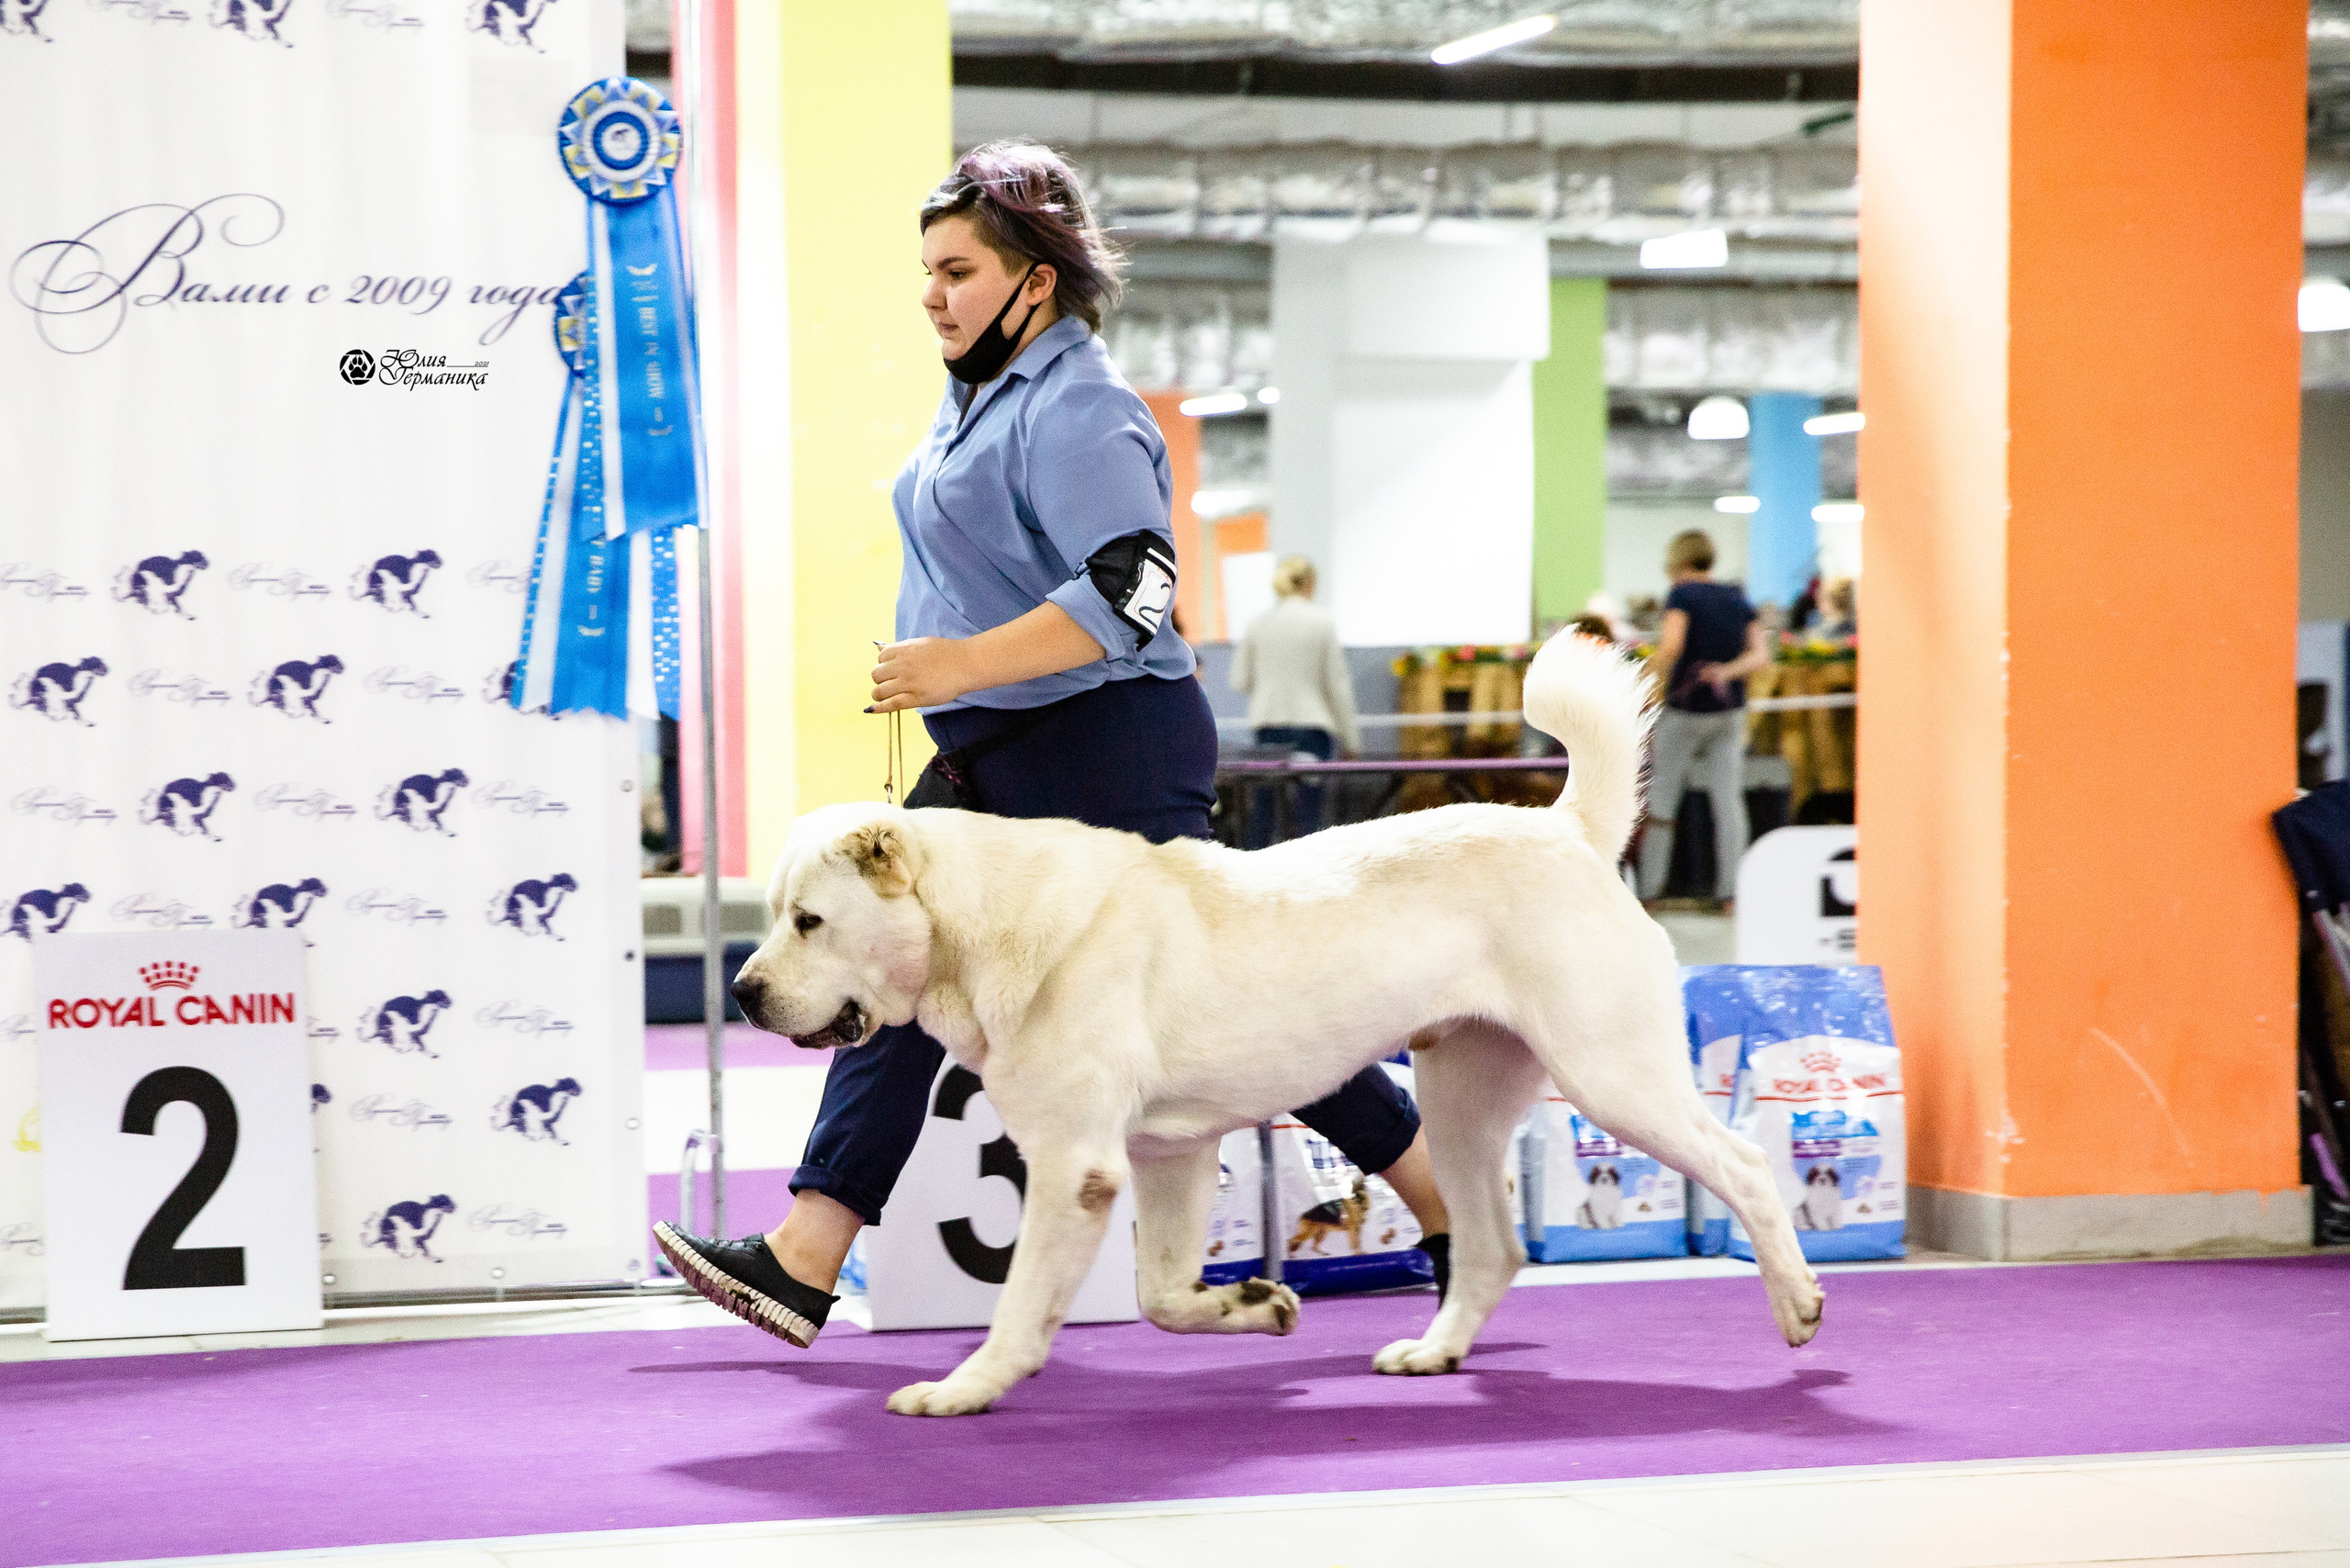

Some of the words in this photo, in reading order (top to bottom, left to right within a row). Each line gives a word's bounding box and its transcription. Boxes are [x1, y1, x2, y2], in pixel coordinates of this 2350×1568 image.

[7, 193, 291, 355] Вами
[306, 280, 331, 305] с
[344, 274, 453, 315] 2009
[48, 996, 168, 1029] ROYAL
[174, 991, 297, 1026] CANIN
[119, 1065, 248, 1291] 2
[933, 1063, 1028, 1285] 3
